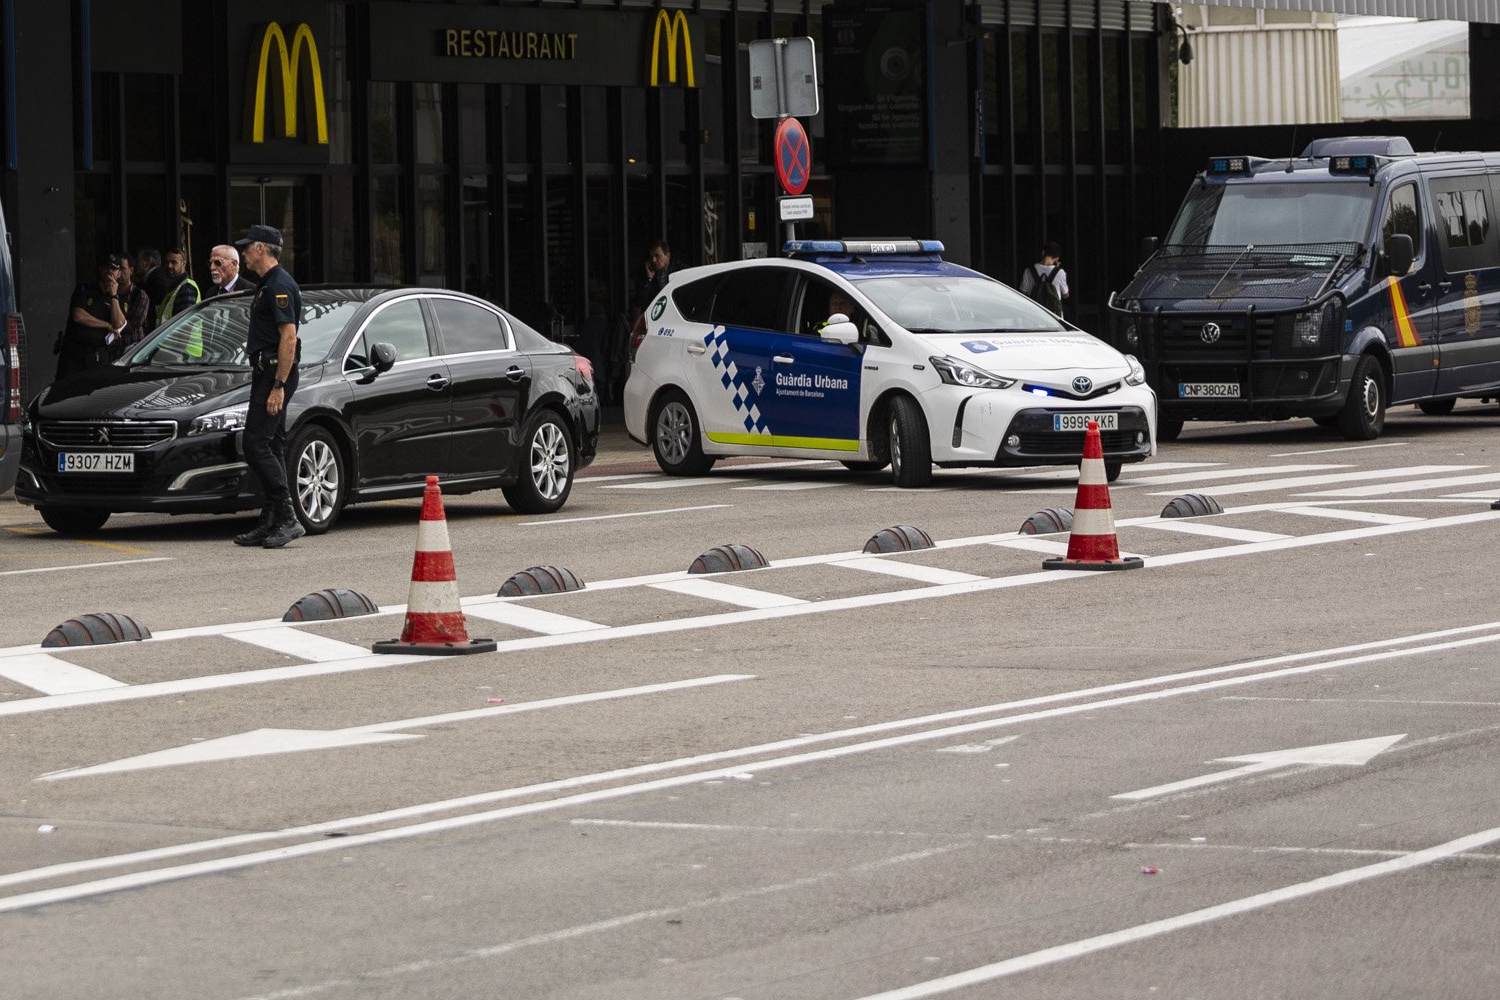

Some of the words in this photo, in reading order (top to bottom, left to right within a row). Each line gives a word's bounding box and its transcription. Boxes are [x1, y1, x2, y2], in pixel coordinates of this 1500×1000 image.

[446, 28, 579, 60] RESTAURANT
[775, 371, 813, 388] Guàrdia
[814, 374, 849, 390] Urbana
[1184, 384, 1239, 396] CNP3802AR
[66, 454, 100, 470] 9307
[105, 455, 132, 470] HZM
